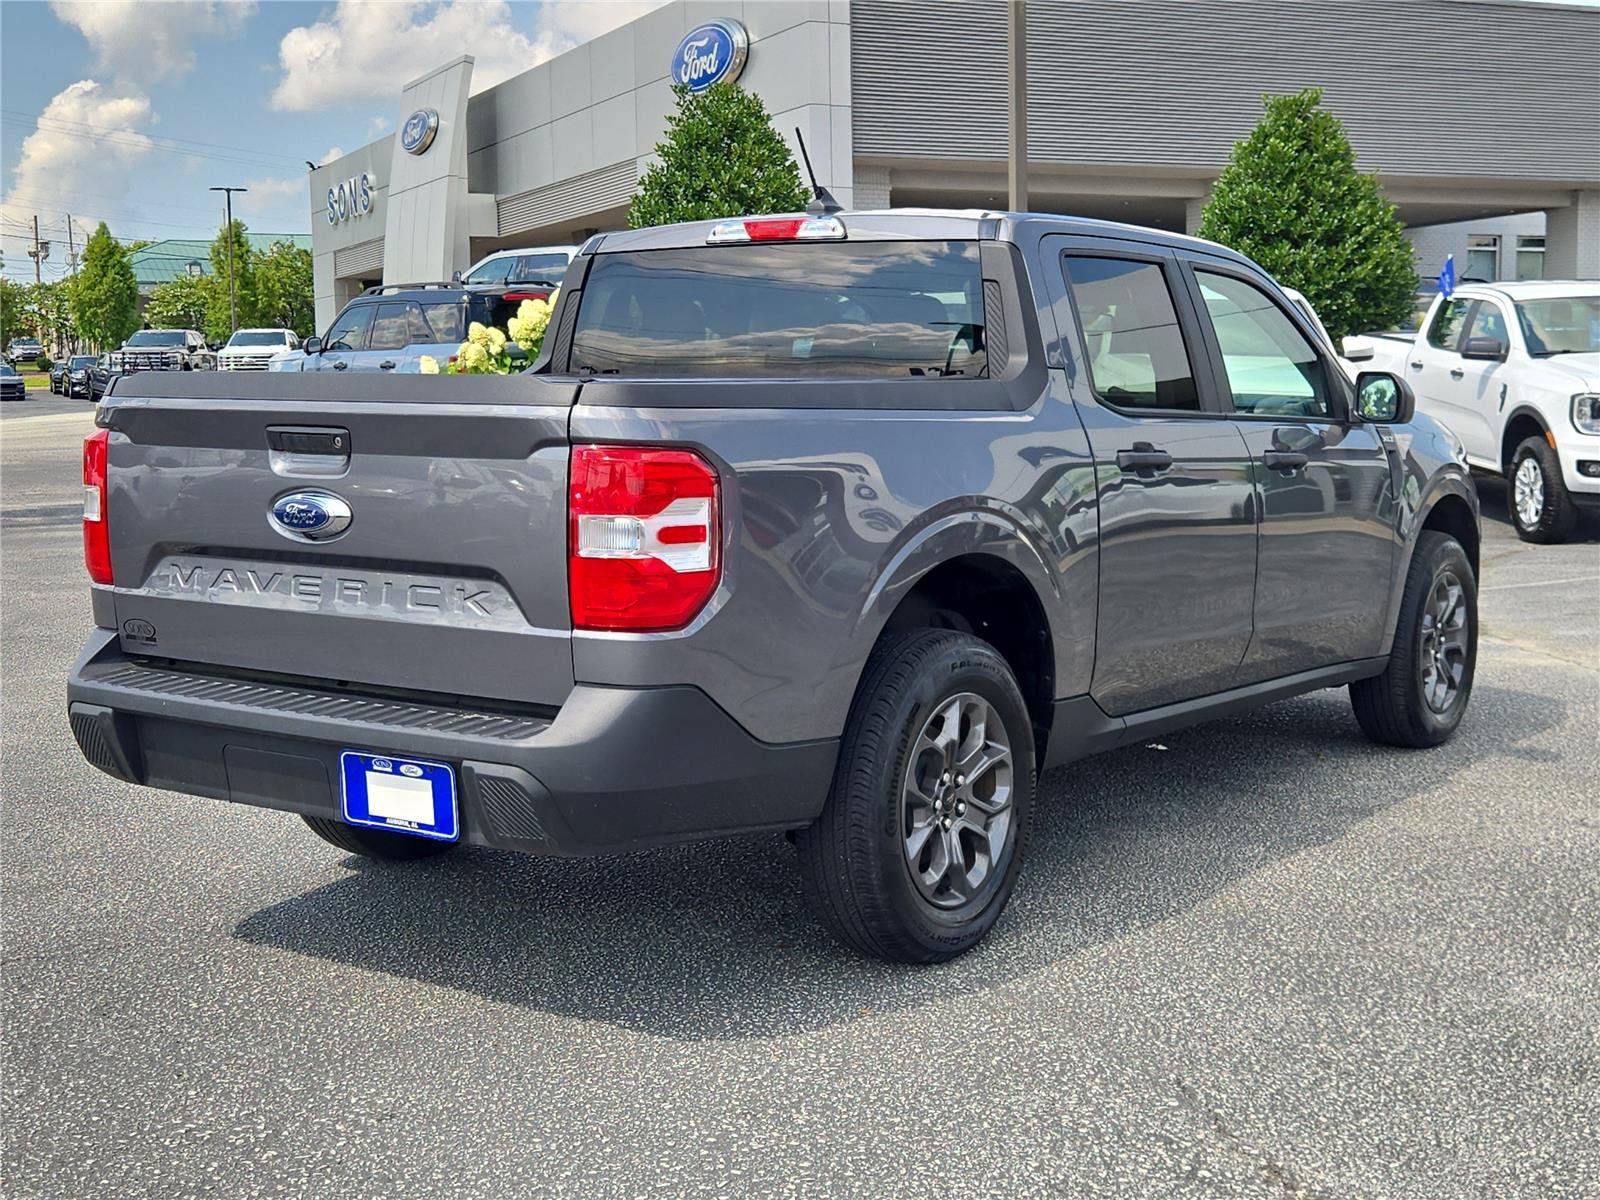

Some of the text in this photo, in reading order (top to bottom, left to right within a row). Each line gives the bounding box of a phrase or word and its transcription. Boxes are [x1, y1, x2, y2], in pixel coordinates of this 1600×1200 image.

[681, 37, 719, 84] Ford
[403, 117, 424, 145] Ford
[327, 172, 371, 225] SONS
[282, 503, 317, 525] Ford
[168, 563, 494, 617] MAVERICK
